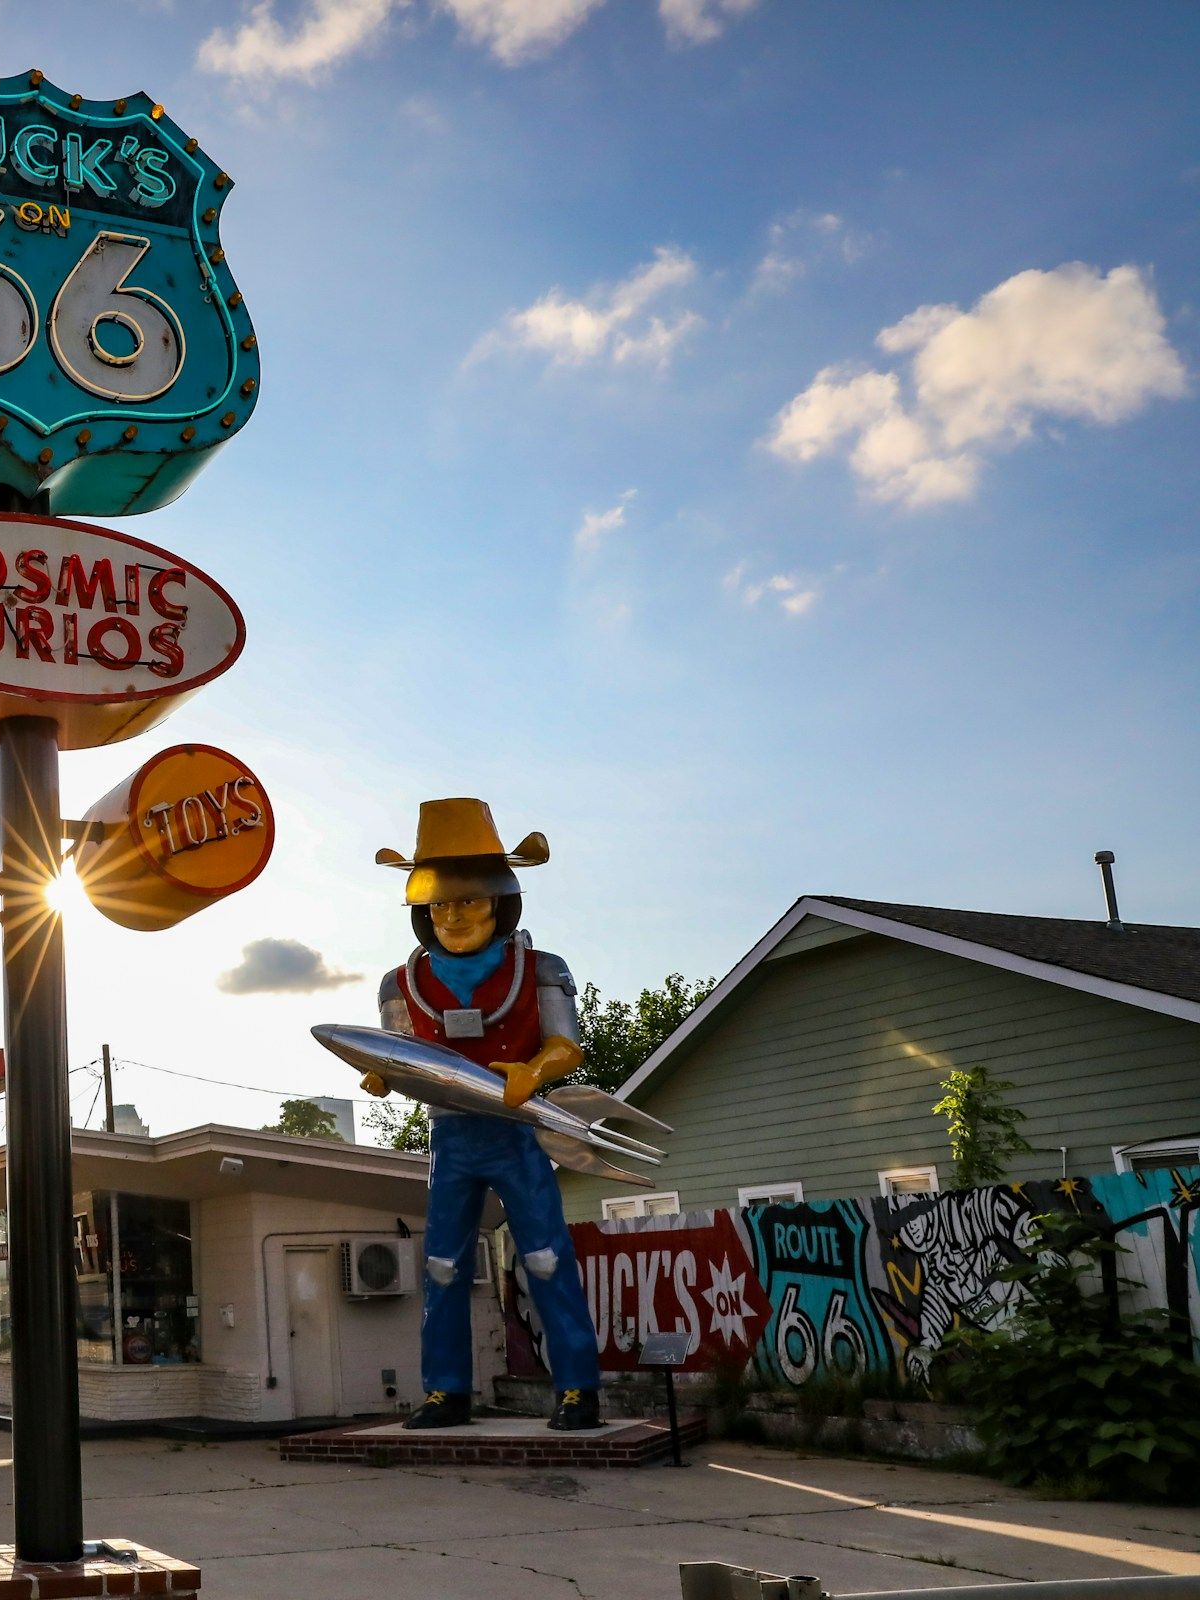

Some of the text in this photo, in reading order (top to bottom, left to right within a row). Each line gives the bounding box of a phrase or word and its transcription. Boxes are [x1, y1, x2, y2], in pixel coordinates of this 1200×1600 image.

[14, 202, 71, 238] ON
[150, 776, 263, 857] TOYS
[774, 1223, 844, 1266] ROUTE
[578, 1250, 701, 1355] UCK'S
[716, 1290, 742, 1316] ON
[776, 1283, 868, 1386] 66
